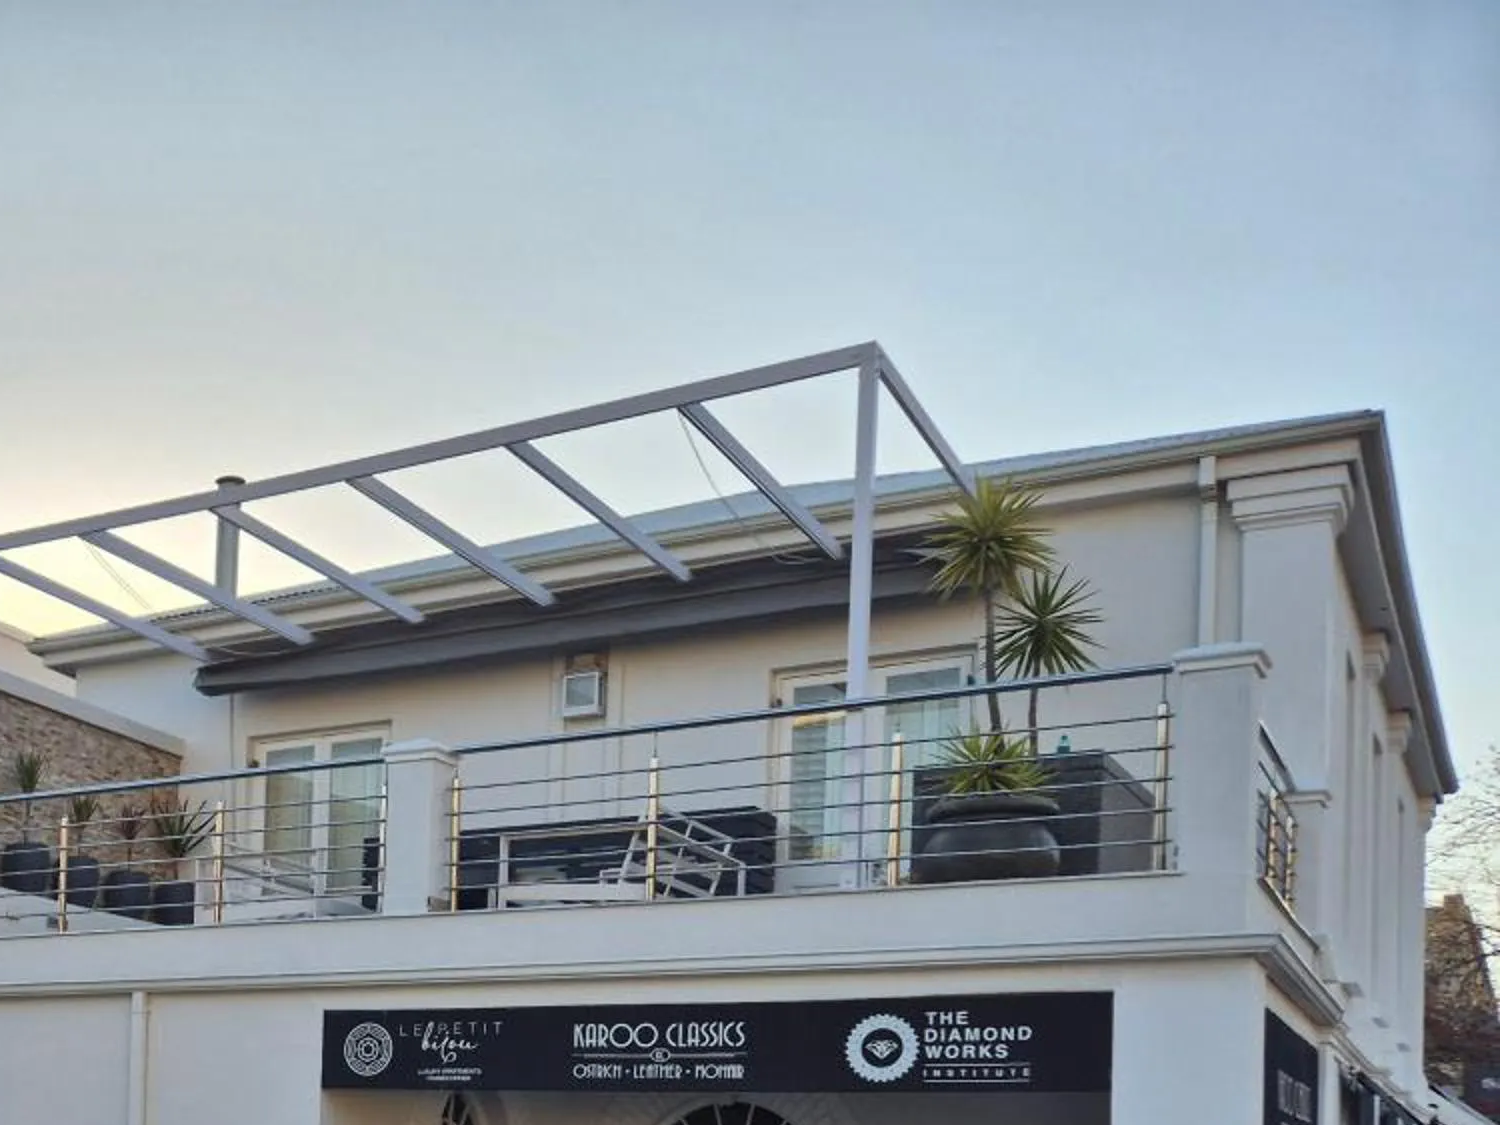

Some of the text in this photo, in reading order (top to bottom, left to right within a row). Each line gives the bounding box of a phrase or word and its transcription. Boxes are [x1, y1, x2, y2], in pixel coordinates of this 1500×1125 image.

[924, 1011, 969, 1025] THE
[399, 1021, 503, 1037] LE PETIT
[573, 1021, 746, 1048] KAROO CLASSICS
[923, 1026, 1032, 1043] DIAMOND
[421, 1021, 479, 1064] bijou
[924, 1044, 1009, 1059] WORKS
[573, 1063, 746, 1079] OSTRICH LEATHER MOHAIR
[922, 1067, 1032, 1078] INSTITUTE
